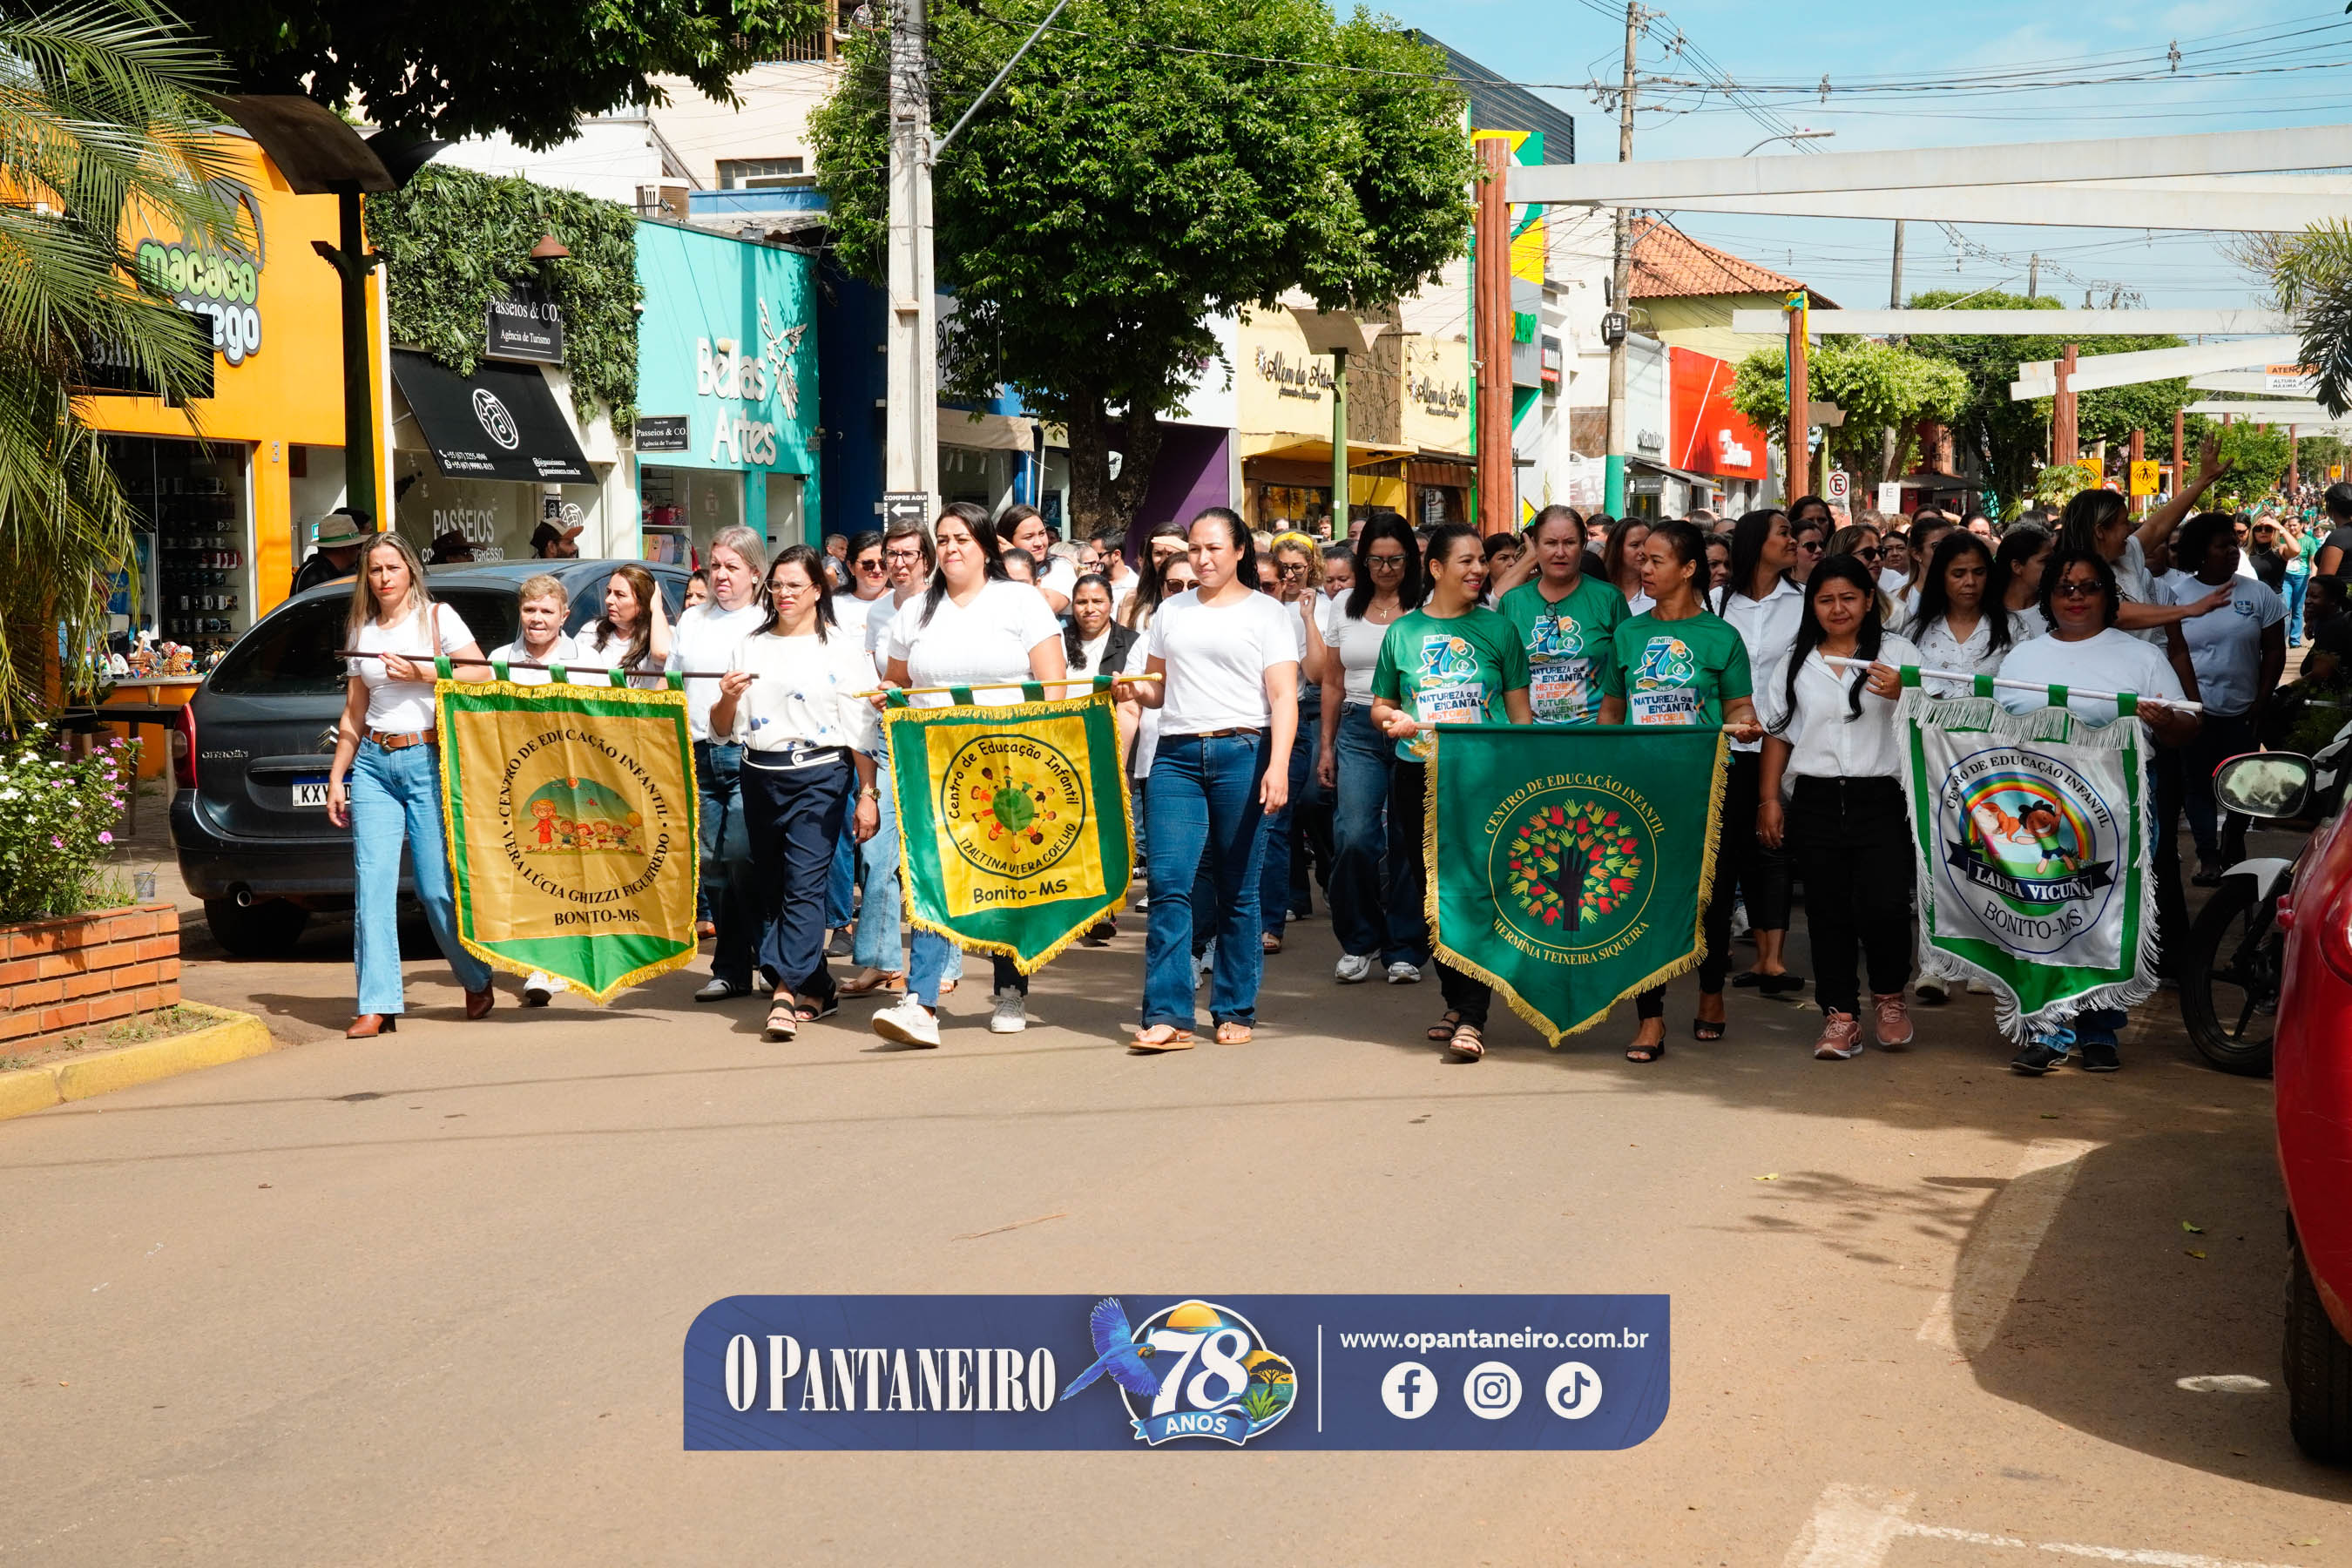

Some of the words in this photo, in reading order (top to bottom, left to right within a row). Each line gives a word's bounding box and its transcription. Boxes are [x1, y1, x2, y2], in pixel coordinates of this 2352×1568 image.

[139, 242, 257, 305] macaco
[489, 294, 528, 318] Passeios
[530, 301, 539, 319] &
[179, 299, 260, 361] ego
[500, 329, 522, 341] Agência
[522, 332, 529, 341] de
[530, 332, 551, 345] Turismo
[697, 337, 767, 402] Bellas
[1295, 357, 1307, 386] da
[710, 407, 777, 466] Artes
[433, 508, 495, 544] PASSEIOS
[1419, 691, 1464, 704] NATUREZA
[1538, 697, 1572, 707] FUTURO
[1633, 694, 1679, 706] NATUREZA
[201, 749, 249, 760] CITROËN
[499, 758, 521, 817] CENTRO
[517, 740, 538, 760] DE
[537, 729, 618, 759] EDUCAÇÃO
[618, 754, 668, 820] INFANTIL
[949, 771, 964, 820] Centro
[962, 753, 977, 768] de
[977, 740, 1041, 760] Educação
[1044, 754, 1079, 805] Infantil
[1969, 760, 1989, 774] DE
[2065, 774, 2110, 828] INFANTIL
[1484, 788, 1525, 835] CENTRO
[1526, 778, 1545, 794] DE
[1546, 773, 1622, 793] EDUCAÇÃO
[1622, 787, 1666, 837] INFANTIL
[503, 830, 525, 871] VERA
[523, 868, 565, 899] LÚCIA
[568, 889, 620, 904] GHIZZI
[621, 833, 670, 897] FIGUEIREDO
[959, 838, 1007, 871] IZALTINA
[1043, 823, 1077, 862] COELHO
[1975, 866, 2024, 898] LAURA
[2027, 878, 2092, 901] VICUÑA
[554, 909, 640, 926] BONITO-MS
[1984, 900, 2083, 939] BONITO-MS
[1492, 918, 1540, 959] HERMÍNIA
[1544, 949, 1598, 965] TEIXEIRA
[1598, 922, 1649, 960] SIQUEIRA
